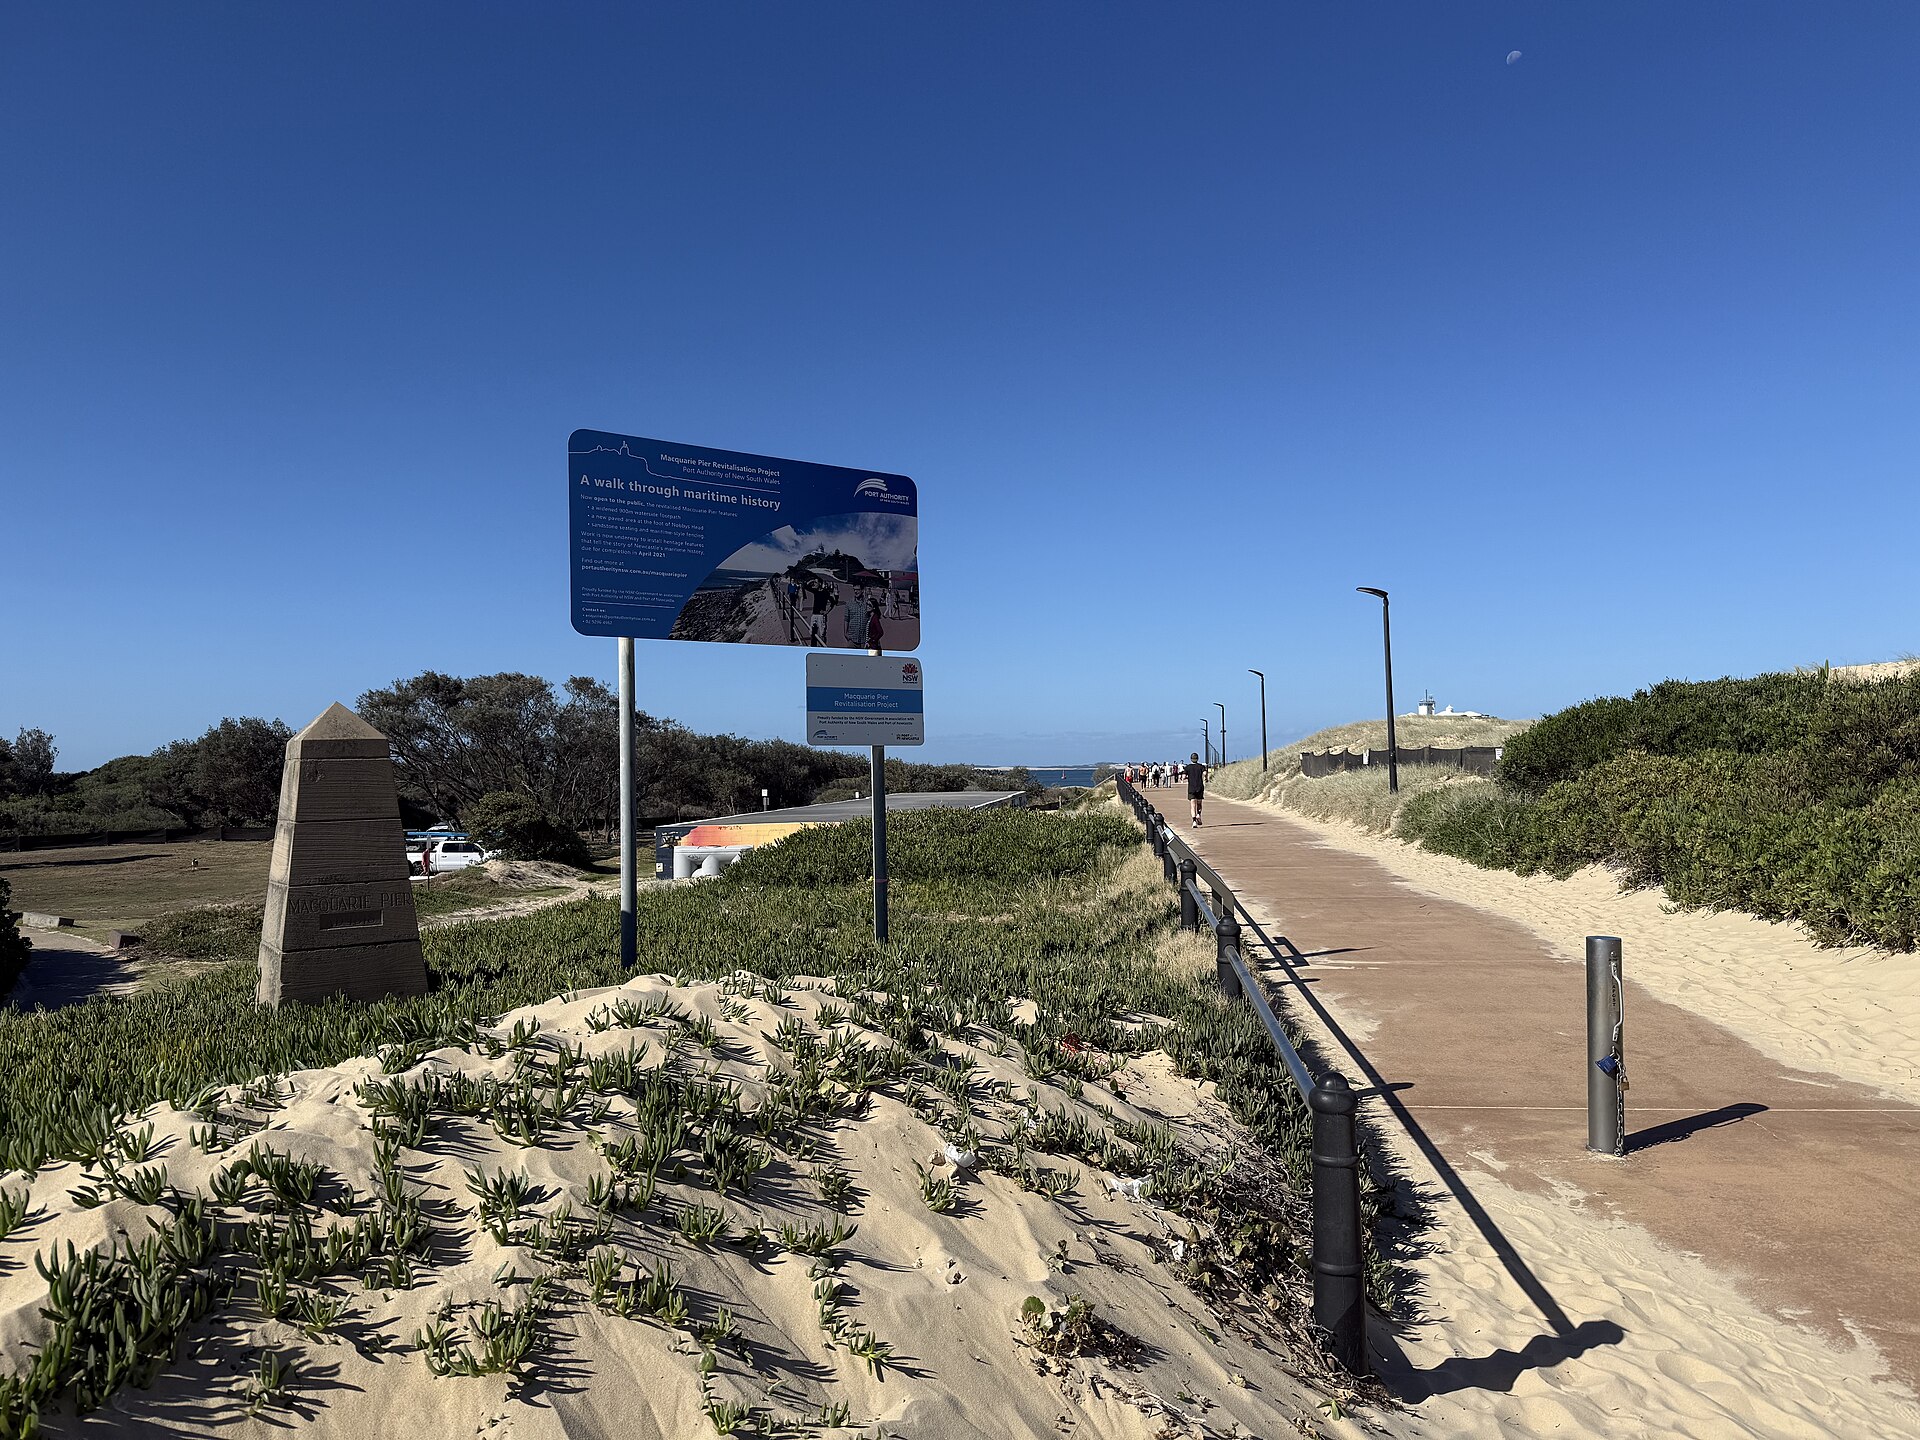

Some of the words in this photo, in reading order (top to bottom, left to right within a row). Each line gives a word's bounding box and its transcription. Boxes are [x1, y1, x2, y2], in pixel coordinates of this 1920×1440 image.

[660, 454, 696, 465] Macquarie
[698, 459, 711, 467] Pier
[712, 462, 756, 473] Revitalisation
[758, 467, 780, 477] Project
[696, 468, 723, 478] Authority
[746, 475, 762, 483] South
[764, 477, 780, 485] Wales
[580, 474, 590, 486] A
[594, 478, 625, 490] walk
[628, 480, 680, 498] through
[684, 490, 738, 504] maritime
[741, 494, 780, 512] history
[880, 492, 910, 502] AUTHORITY
[288, 894, 372, 914] MACQUARIE
[380, 892, 412, 908] PIER
